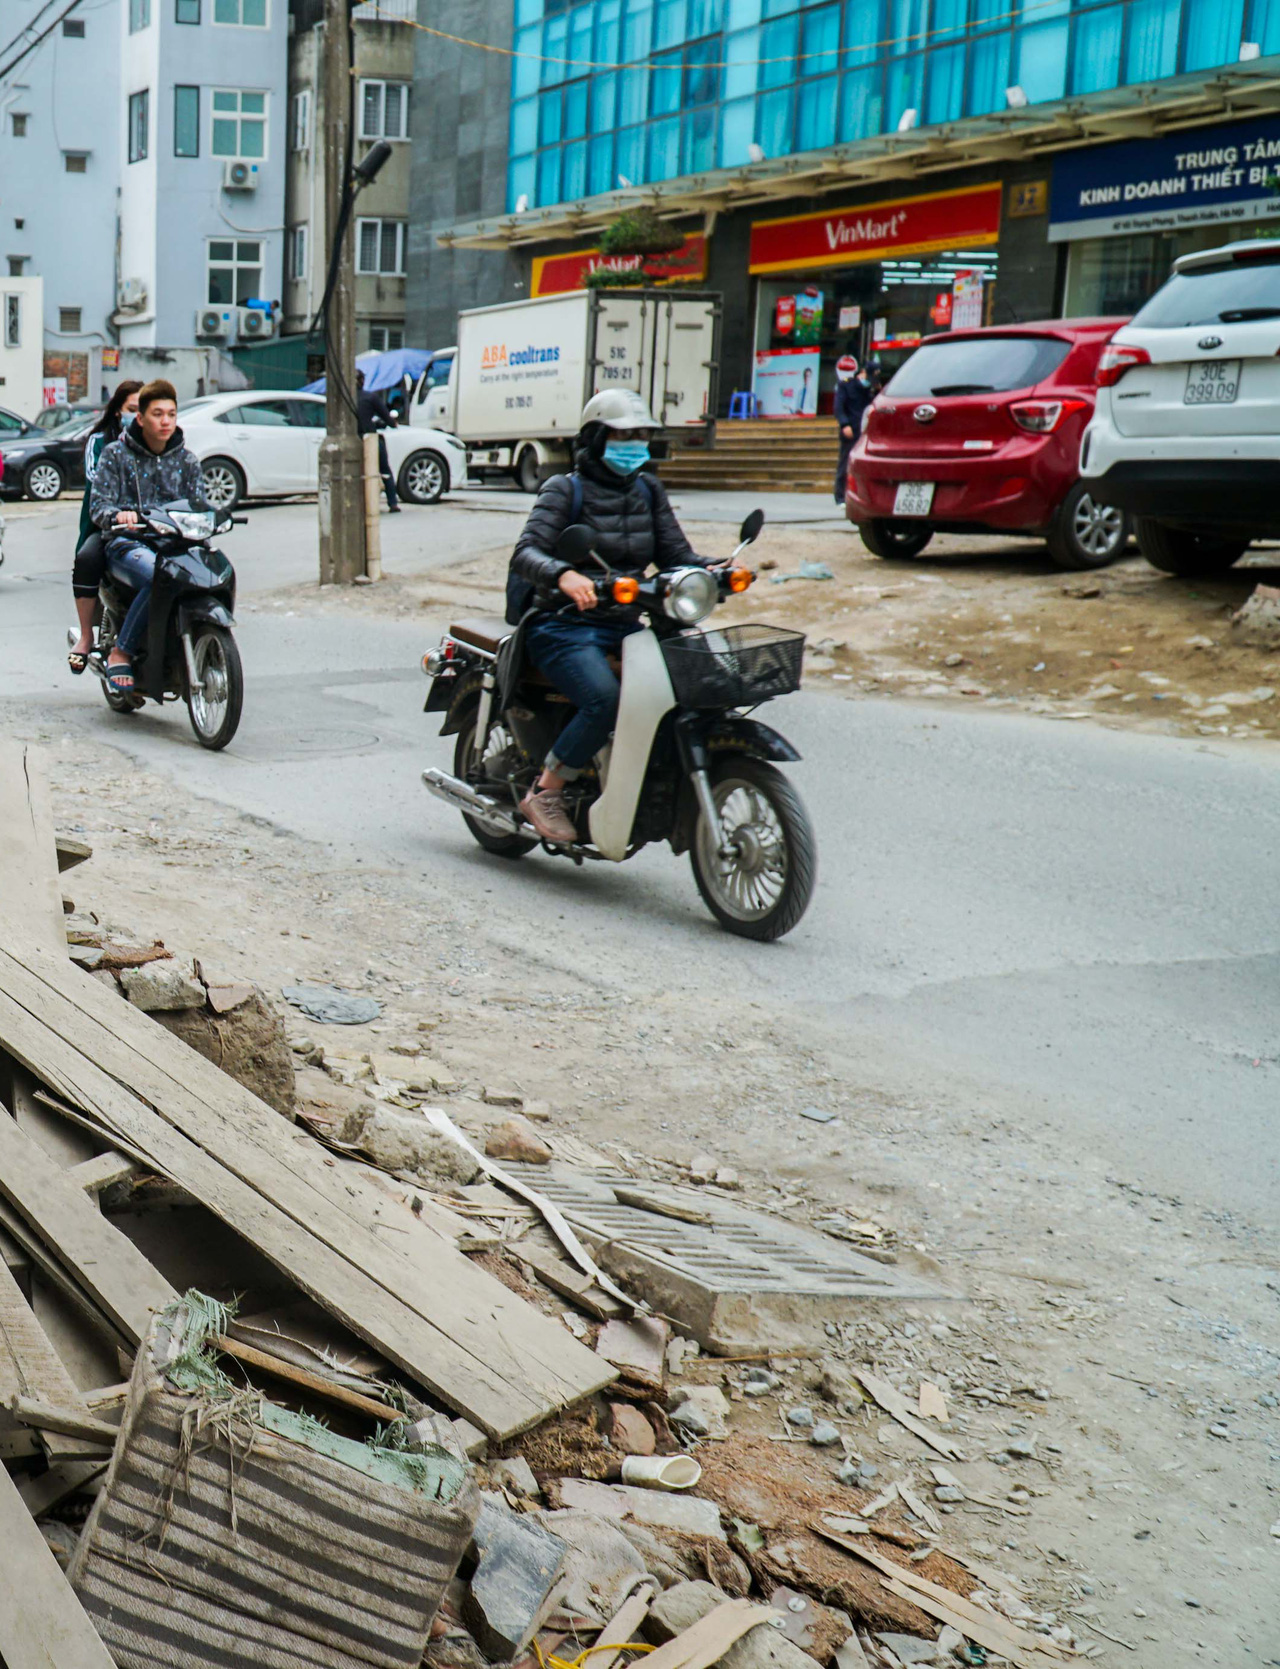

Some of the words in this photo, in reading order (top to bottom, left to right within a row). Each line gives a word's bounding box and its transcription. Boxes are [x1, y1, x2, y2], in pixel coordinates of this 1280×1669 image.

[1175, 147, 1238, 170] TRUNG
[1079, 187, 1121, 206] KINH
[1124, 177, 1187, 200] DOANH
[1191, 163, 1245, 191] THIẾT
[482, 344, 507, 363] ABA
[509, 345, 560, 366] cooltrans
[1200, 361, 1227, 381] 30E
